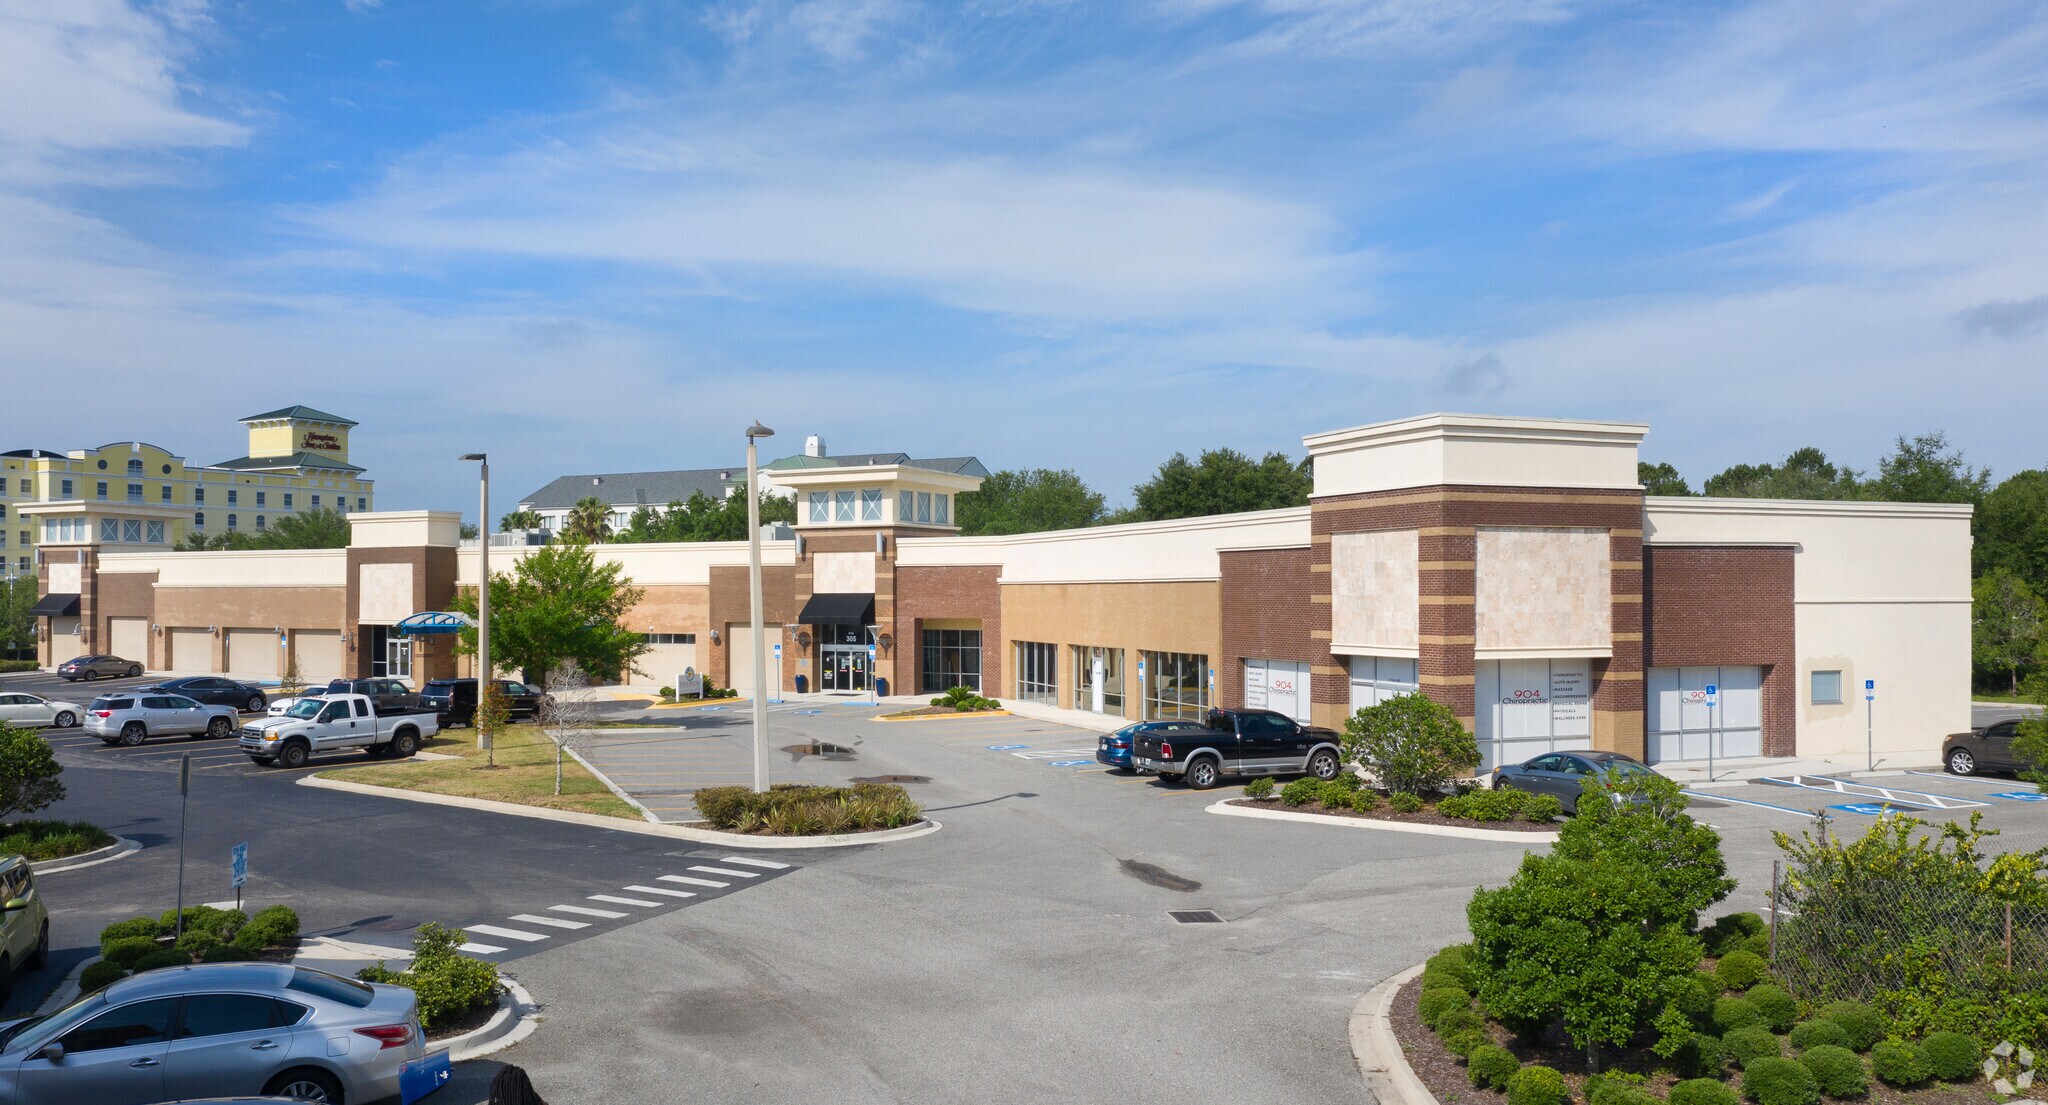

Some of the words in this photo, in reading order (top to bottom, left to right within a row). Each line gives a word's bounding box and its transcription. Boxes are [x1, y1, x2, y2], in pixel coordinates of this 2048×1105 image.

[1276, 680, 1291, 689] 904
[1515, 690, 1540, 698] 904
[1503, 697, 1548, 705] Chiropractic
